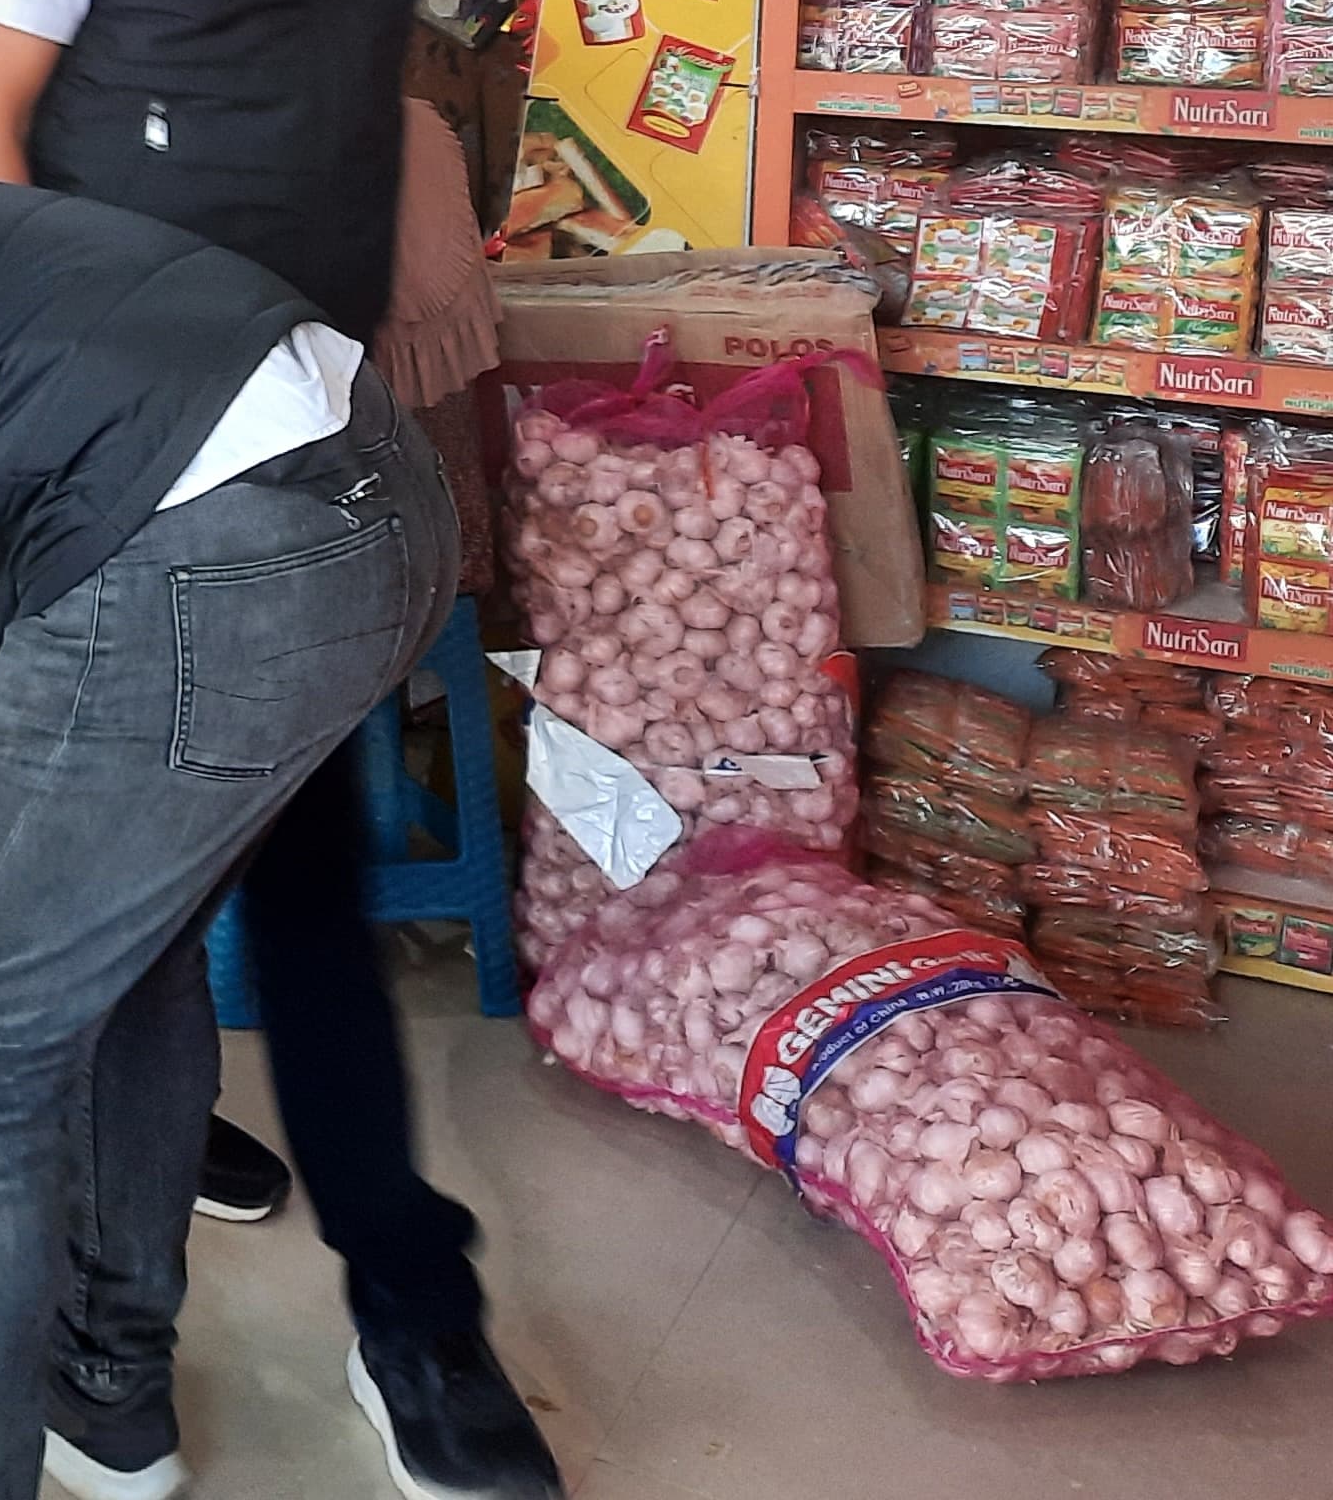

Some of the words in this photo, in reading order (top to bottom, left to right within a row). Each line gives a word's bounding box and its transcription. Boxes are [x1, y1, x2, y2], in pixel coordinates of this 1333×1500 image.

[1174, 96, 1269, 126] NutriSari
[1160, 363, 1254, 396] NutriSari
[1147, 622, 1240, 659] NutriSari
